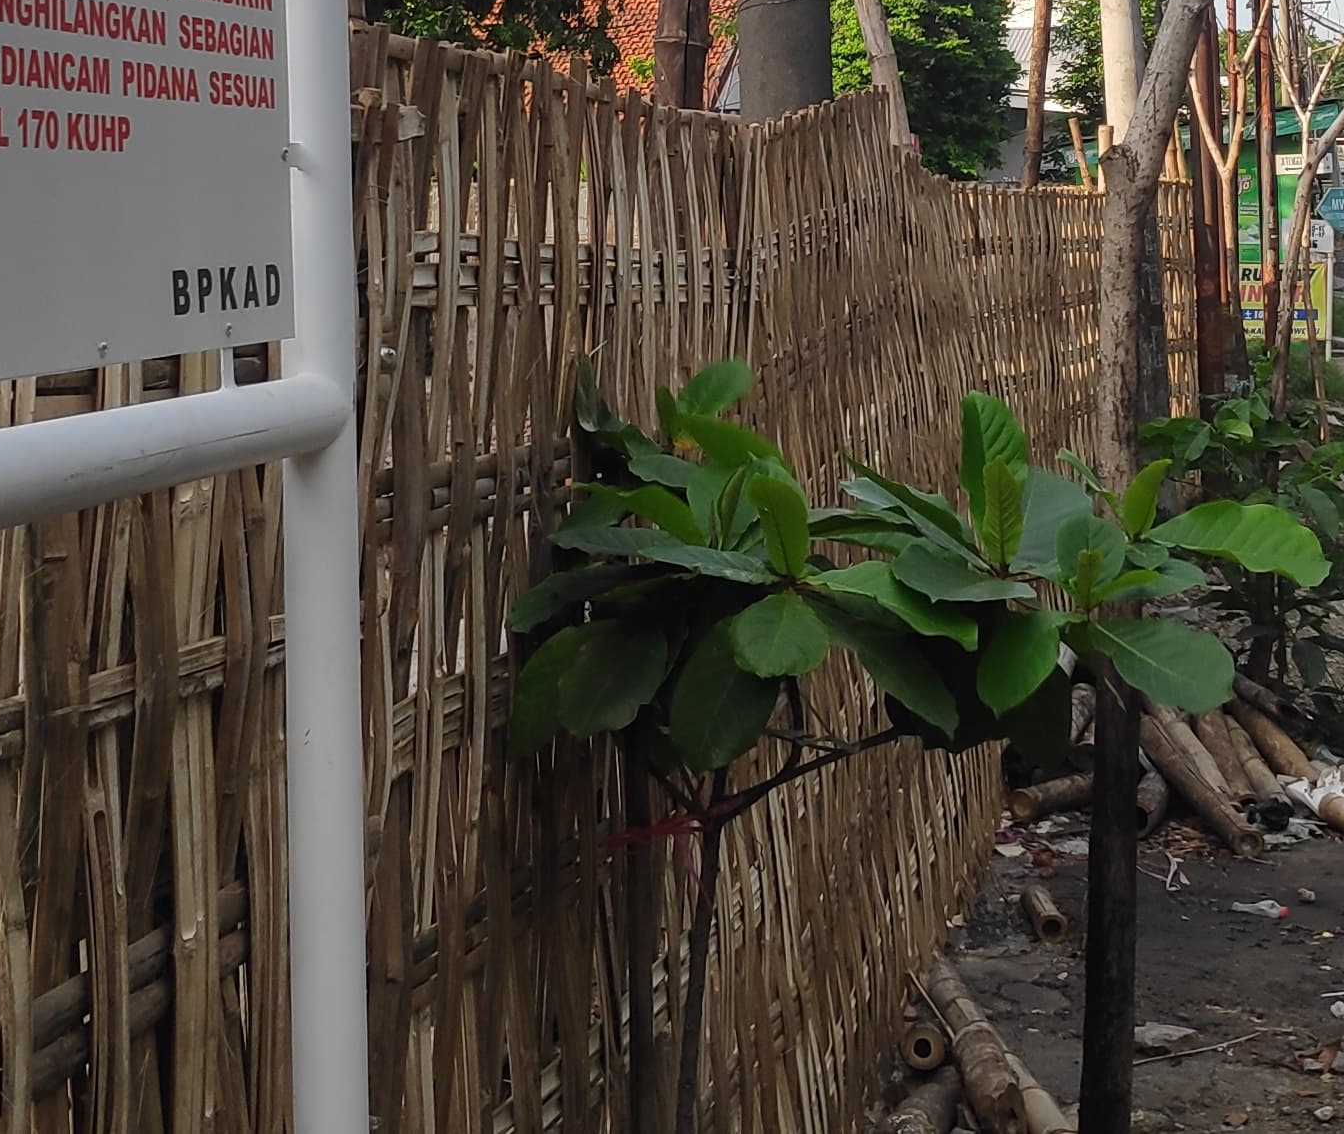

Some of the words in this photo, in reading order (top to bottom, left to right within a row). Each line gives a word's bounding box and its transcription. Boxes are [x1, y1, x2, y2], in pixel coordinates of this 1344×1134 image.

[178, 14, 274, 61] SEBAGIAN
[1, 45, 111, 95] DIANCAM
[122, 60, 200, 103] PIDANA
[209, 71, 275, 110] SESUAI
[17, 108, 59, 150] 170
[67, 112, 131, 153] KUHP
